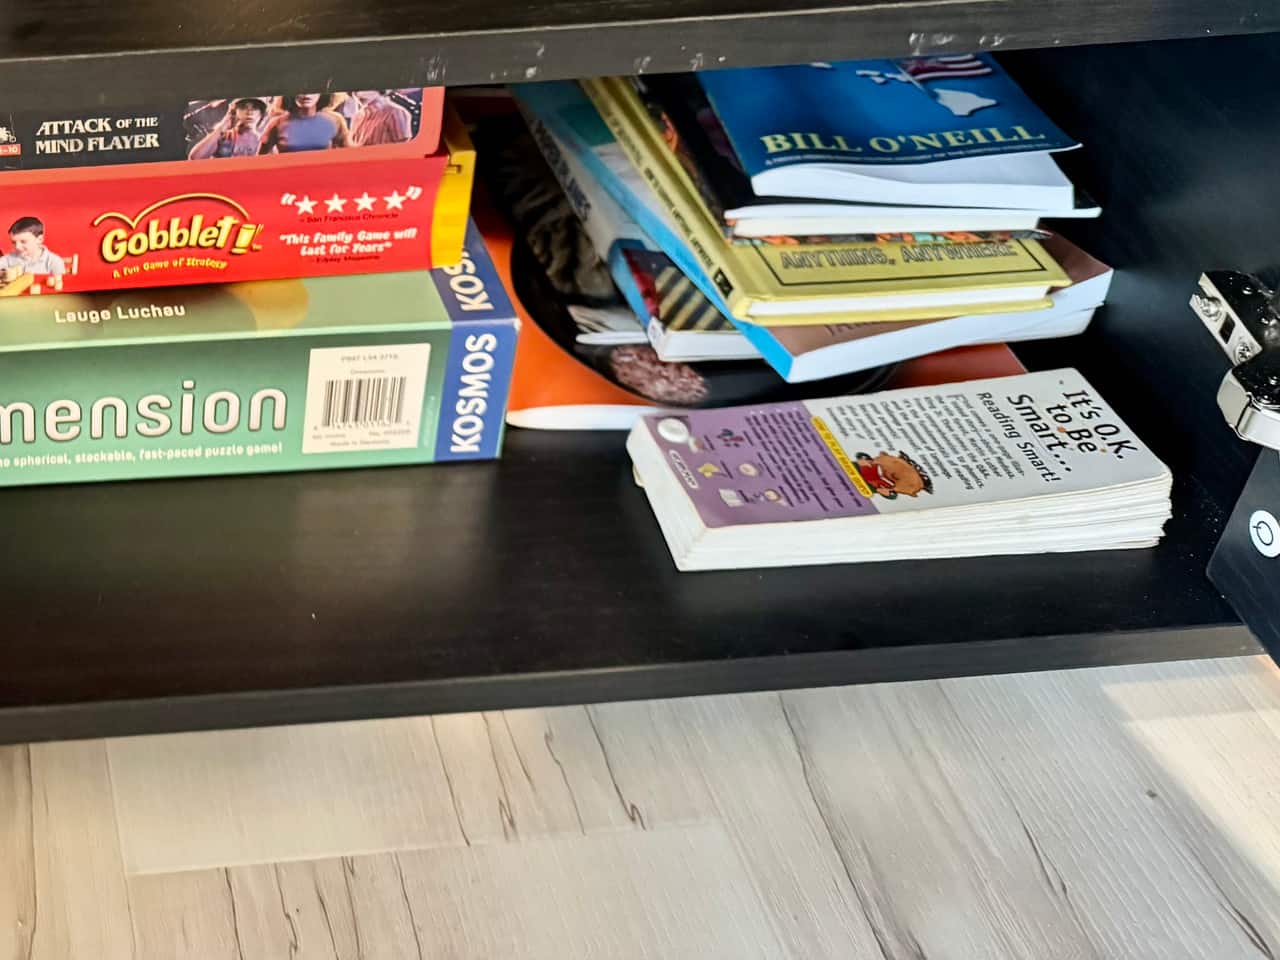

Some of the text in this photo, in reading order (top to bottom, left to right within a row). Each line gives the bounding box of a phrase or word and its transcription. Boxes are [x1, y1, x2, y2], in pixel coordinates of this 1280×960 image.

[36, 117, 158, 136] ATTACK OF THE
[760, 132, 863, 154] BILL
[869, 125, 1046, 153] O'NEILL
[36, 133, 160, 155] MIND FLAYER
[313, 230, 353, 244] Family
[357, 230, 390, 241] Game
[780, 242, 1019, 269] ANYTHING, ANYWHERE
[443, 250, 494, 311] KOS
[55, 303, 186, 325] Lauge Luchau
[450, 332, 497, 453] KOSMOS
[978, 393, 1060, 481] Reading Smart!
[1007, 395, 1071, 471] Smart...
[1046, 404, 1105, 452] to Be
[1063, 391, 1137, 458] It's O.K.
[14, 452, 72, 467] spherical,
[75, 449, 136, 464] stackable,
[139, 446, 202, 461] fast-paced
[205, 444, 244, 458] puzzle
[247, 442, 283, 456] game!
